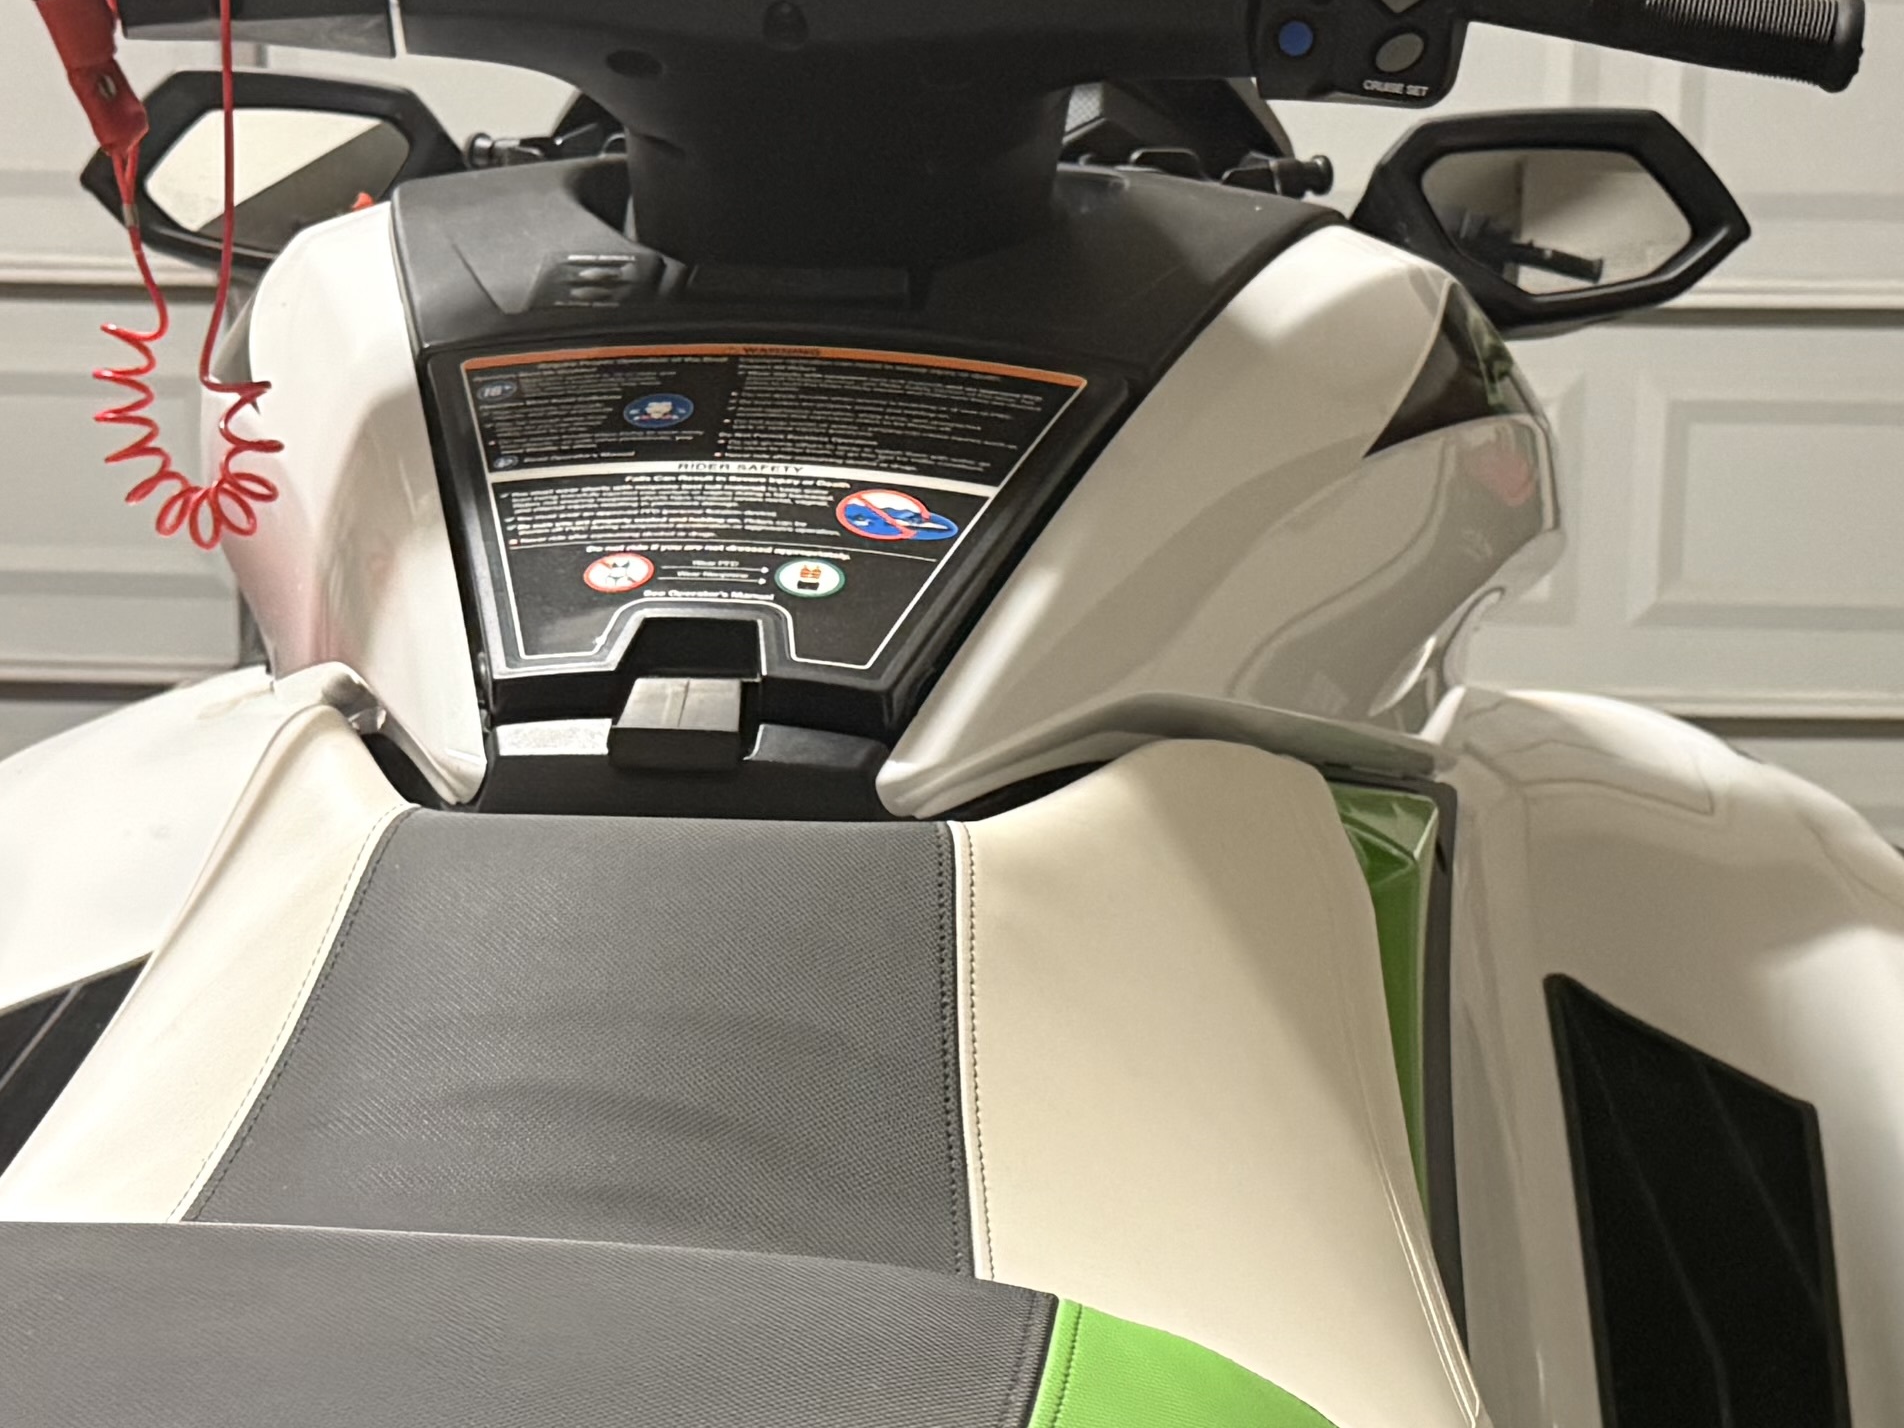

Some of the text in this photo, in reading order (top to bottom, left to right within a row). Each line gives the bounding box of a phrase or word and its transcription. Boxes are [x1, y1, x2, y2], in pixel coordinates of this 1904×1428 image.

[1363, 80, 1429, 96] CRUISE SET
[678, 462, 804, 474] RIDER SAFETY
